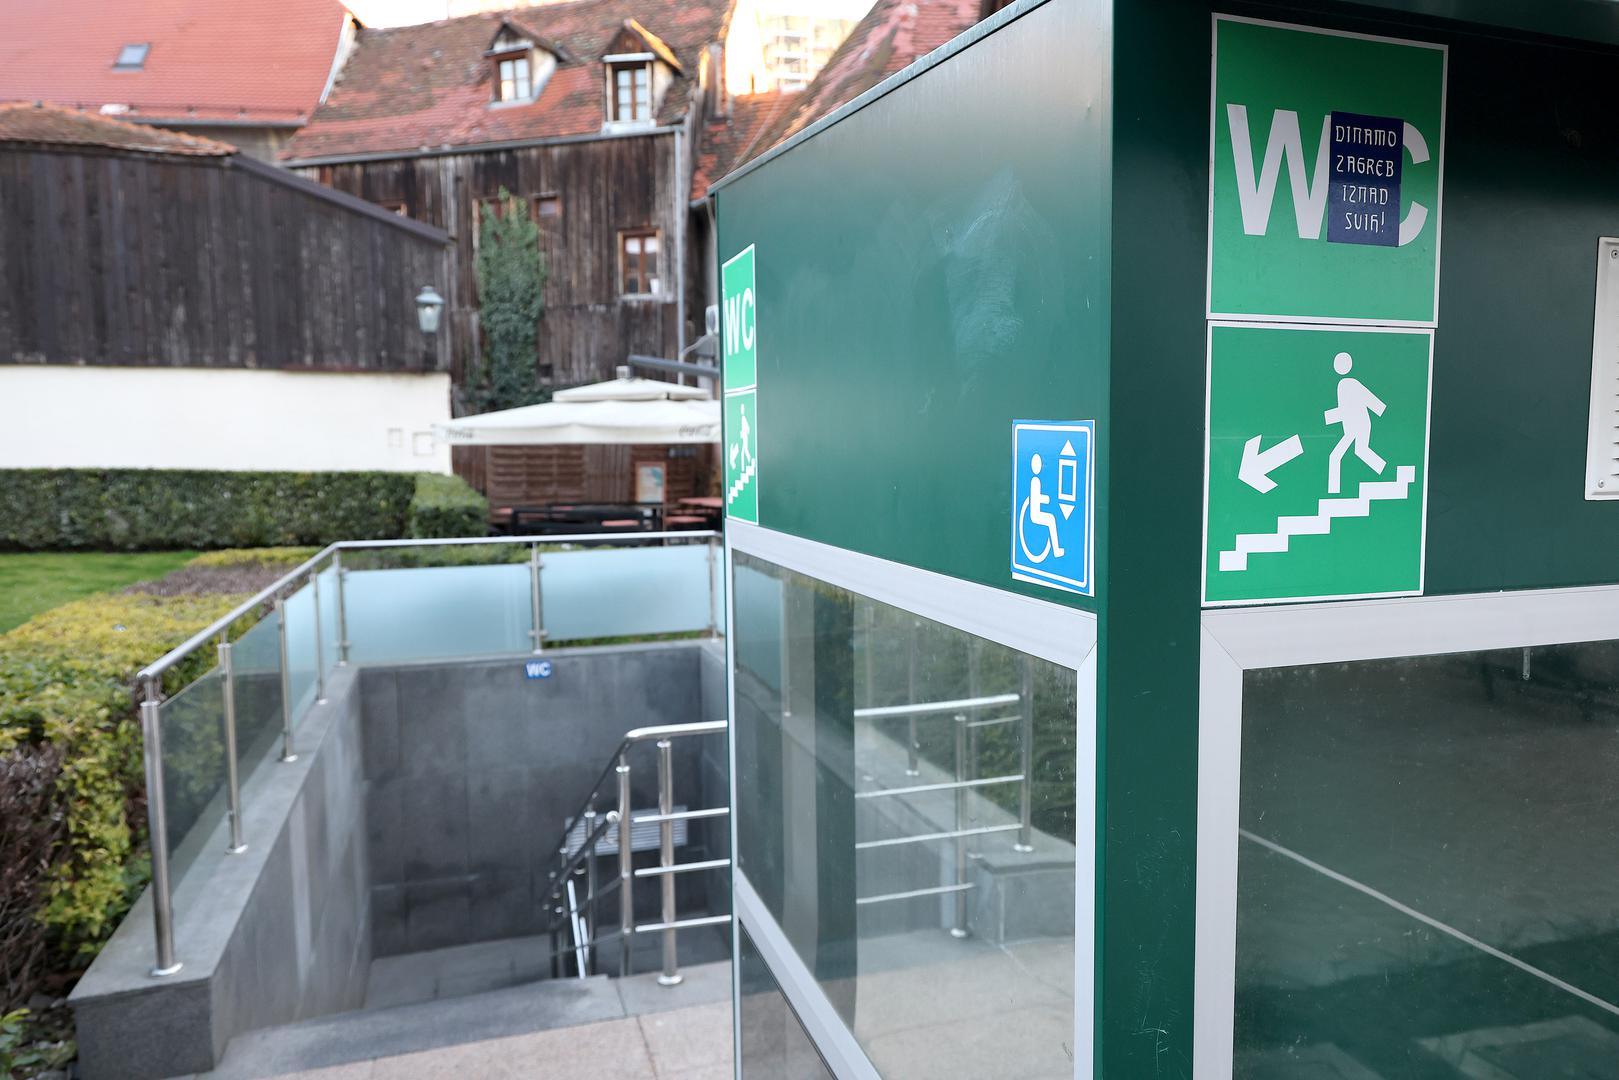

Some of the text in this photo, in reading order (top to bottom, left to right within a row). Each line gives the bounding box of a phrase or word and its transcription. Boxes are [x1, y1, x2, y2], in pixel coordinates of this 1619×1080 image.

[1335, 125, 1397, 148] DINAMO
[1336, 154, 1394, 177] ZAGREB
[1342, 184, 1388, 206] IZNAD
[724, 287, 754, 356] WC
[526, 662, 551, 677] WC
